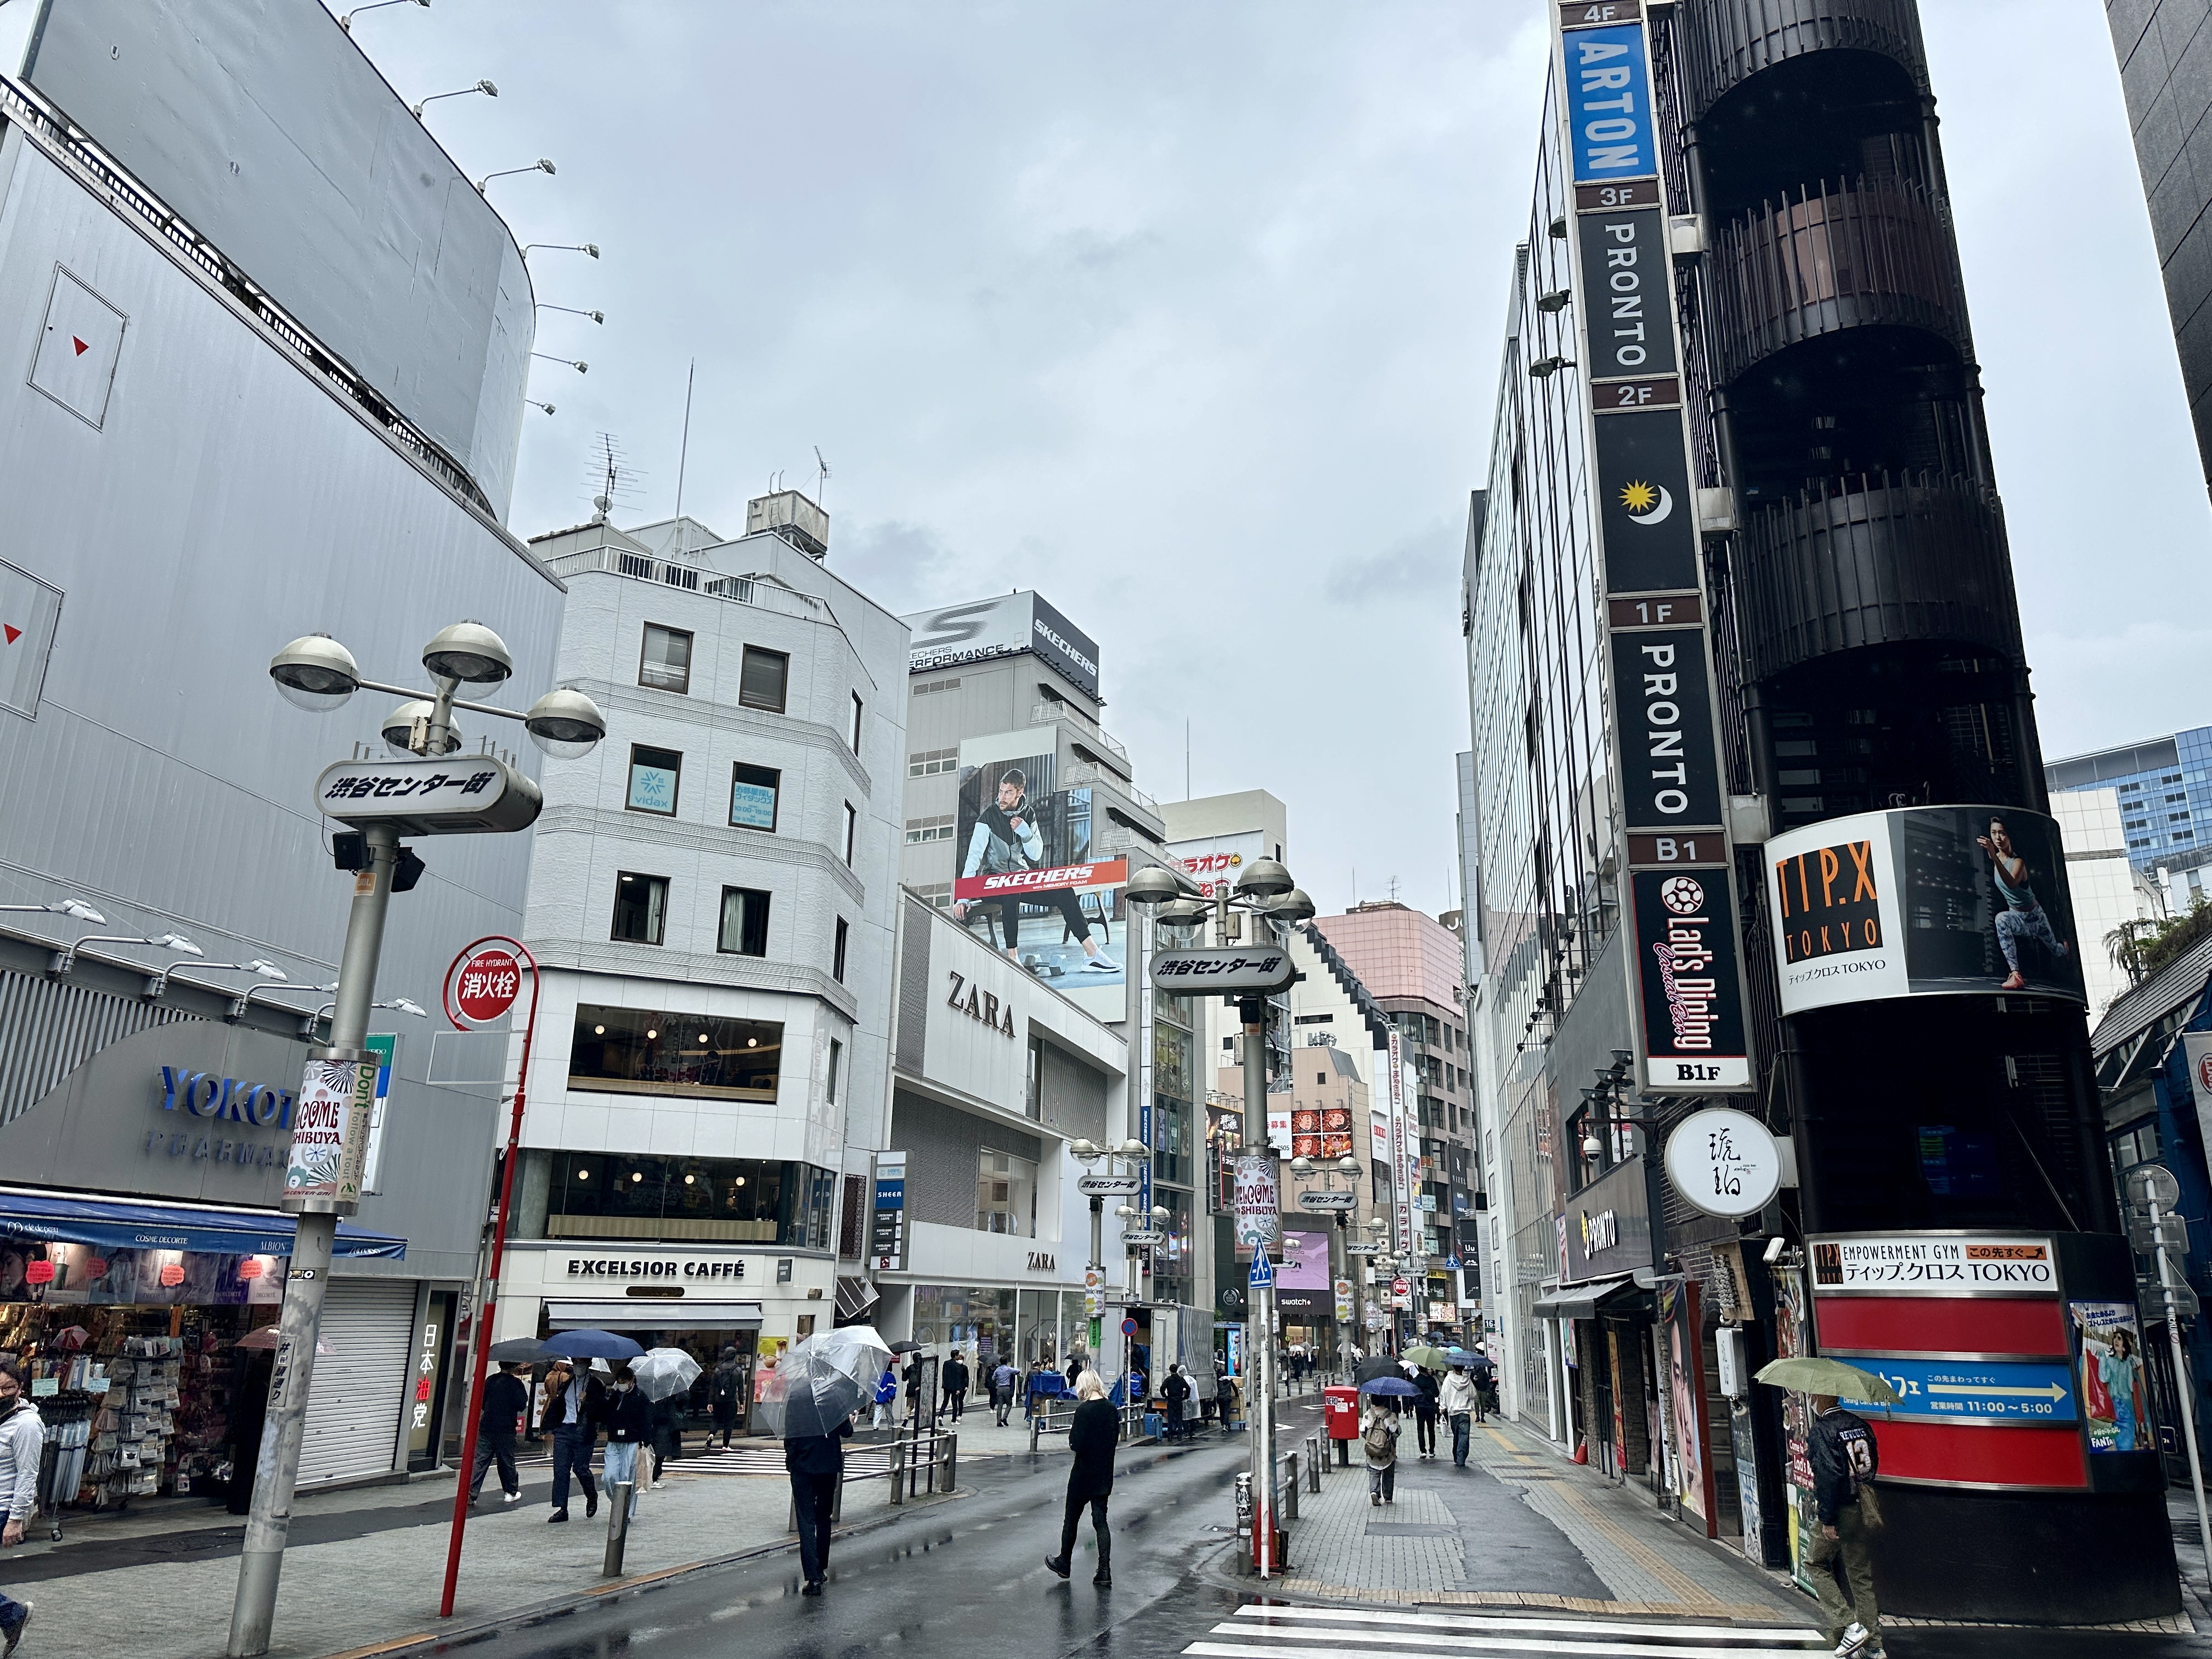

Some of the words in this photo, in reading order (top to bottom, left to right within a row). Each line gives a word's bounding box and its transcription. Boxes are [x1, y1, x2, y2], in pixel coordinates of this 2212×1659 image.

[1584, 5, 1615, 22] 4F
[1578, 41, 1639, 170] ARTON
[1600, 187, 1633, 206] 3F
[1605, 222, 1646, 366] PRONTO
[1618, 386, 1652, 406] 2F
[1635, 603, 1672, 623] 1F
[1035, 618, 1097, 677] SKECHERS
[1641, 644, 1689, 814] PRONTO
[325, 771, 496, 799] 渋谷センター街
[736, 785, 773, 798] お部屋探し
[635, 795, 668, 808] vidax
[1656, 838, 1696, 861] B1
[1167, 854, 1231, 874] カラオケ
[359, 878, 371, 886] JBL
[983, 865, 1092, 889] SKECHERS
[1776, 840, 1877, 917] TIP.X
[1667, 917, 1712, 972] Lad's
[1787, 918, 1876, 960] TOKYO
[486, 959, 514, 967] HYDRANT
[1157, 956, 1282, 977] 渋谷センター街
[1842, 959, 1886, 974] TOKYO
[461, 971, 516, 999] 消火栓
[1653, 943, 1684, 1002] Casual
[1669, 1002, 1690, 1035] Bar
[947, 970, 1017, 1038] ZARA
[1672, 978, 1719, 1049] Dining
[1677, 1064, 1720, 1081] B1F
[356, 1065, 376, 1109] Don't
[292, 1131, 342, 1146] SHIBUYA
[349, 1112, 360, 1146] follow
[342, 1157, 353, 1180] tout
[1081, 1180, 1137, 1189] 渋谷センター街
[1235, 1184, 1274, 1204] WELCOME
[1301, 1195, 1353, 1204] 渋谷センター街
[1242, 1206, 1278, 1215] SHIBUYA
[1398, 1205, 1410, 1250] カラオケ
[1588, 1209, 1616, 1254] PRONTO
[136, 1234, 156, 1243] COSME
[158, 1235, 188, 1244] DECORTE
[261, 1241, 285, 1251] ALBION
[1027, 1251, 1056, 1270] ZARA
[1813, 1244, 1841, 1268] TIP.X
[1844, 1245, 1926, 1261] EMPOWERMENT
[1933, 1245, 1959, 1260] GYM
[1969, 1247, 2024, 1259] この先すぐ
[567, 1260, 678, 1277] EXCELSIOR
[684, 1259, 745, 1277] CAFFÉ
[1817, 1272, 1843, 1284] TOKYO
[1968, 1263, 2050, 1282] TOKYO
[270, 1340, 293, 1401] 井頭通り
[411, 1323, 438, 1430] 日本油党
[1927, 1375, 1996, 1384] この先まわってすぐ
[1930, 1401, 1963, 1410] 営業時間
[1789, 1439, 1800, 1451] Come
[2091, 1436, 2114, 1448] FANTA
[1793, 1454, 1807, 1472] Lad's
[1845, 1438, 1872, 1477] 13
